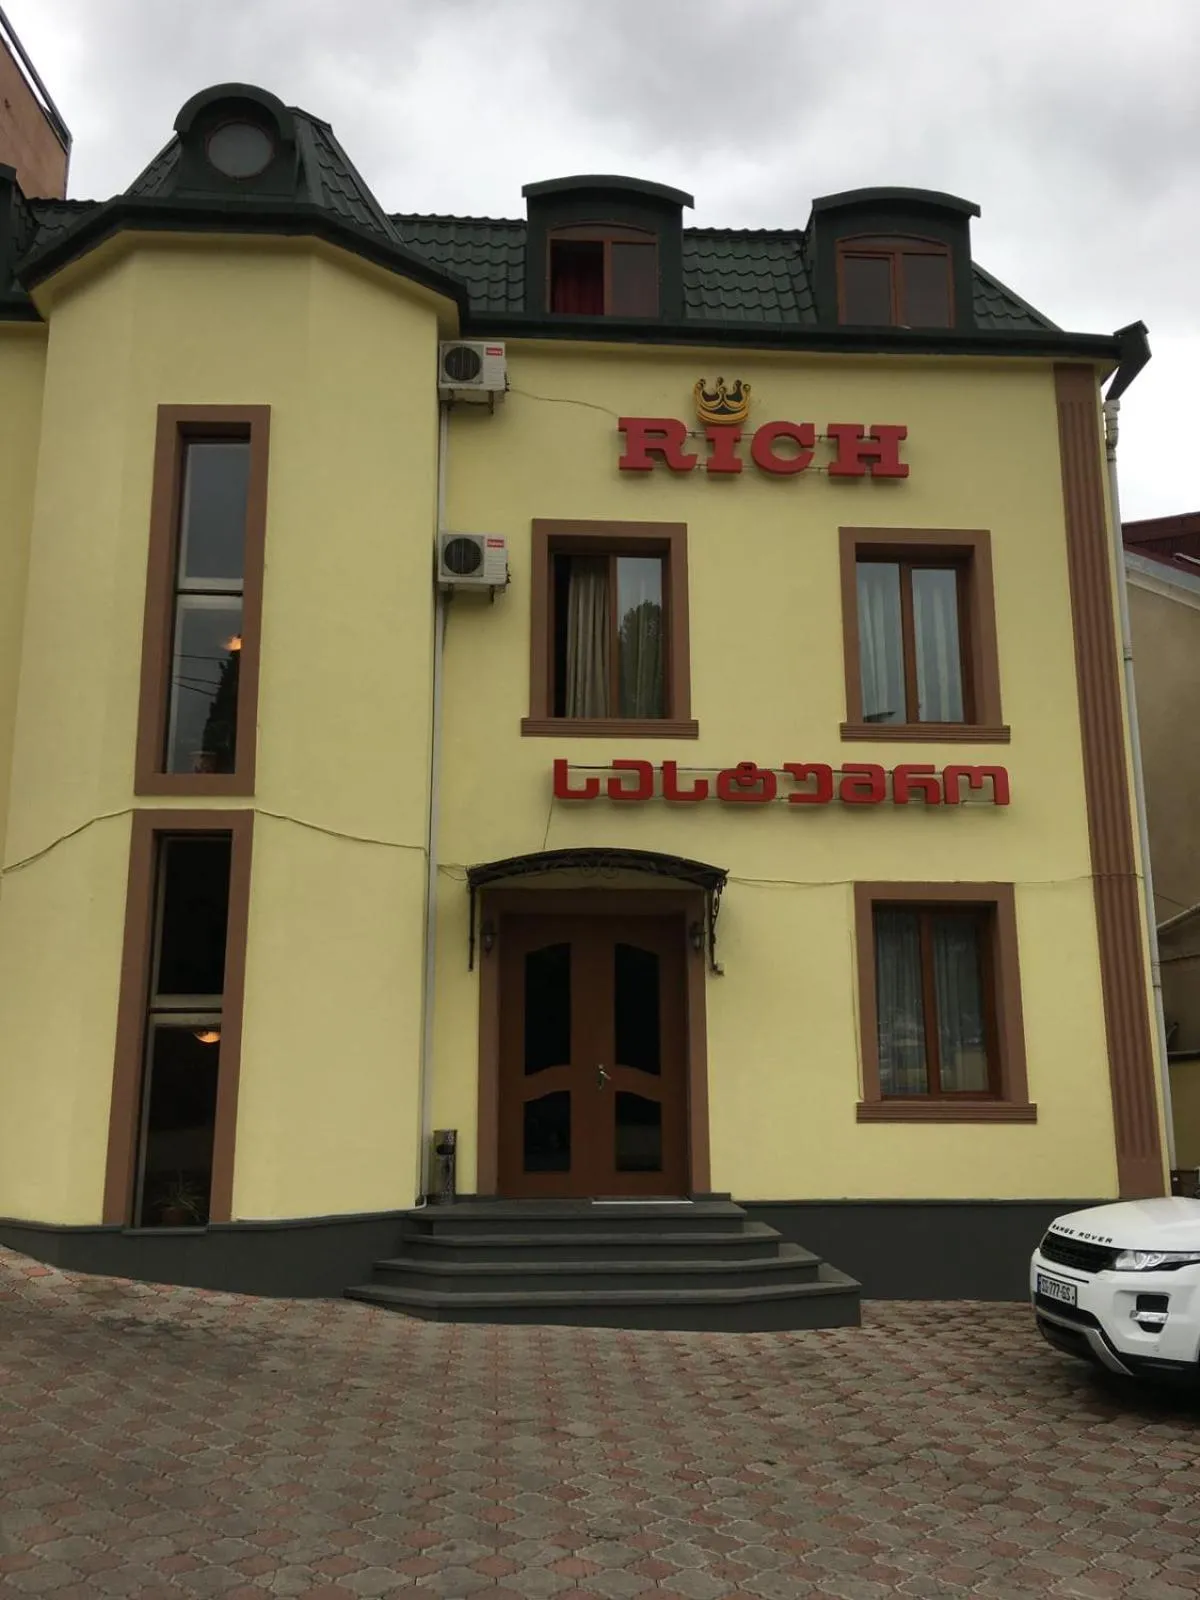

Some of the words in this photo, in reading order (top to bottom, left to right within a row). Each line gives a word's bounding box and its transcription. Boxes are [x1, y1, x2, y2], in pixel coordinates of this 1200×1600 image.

[618, 417, 909, 478] RICH
[553, 758, 1010, 806] სასტუმრო
[1052, 1223, 1075, 1235] RANGE
[1078, 1231, 1113, 1244] ROVER
